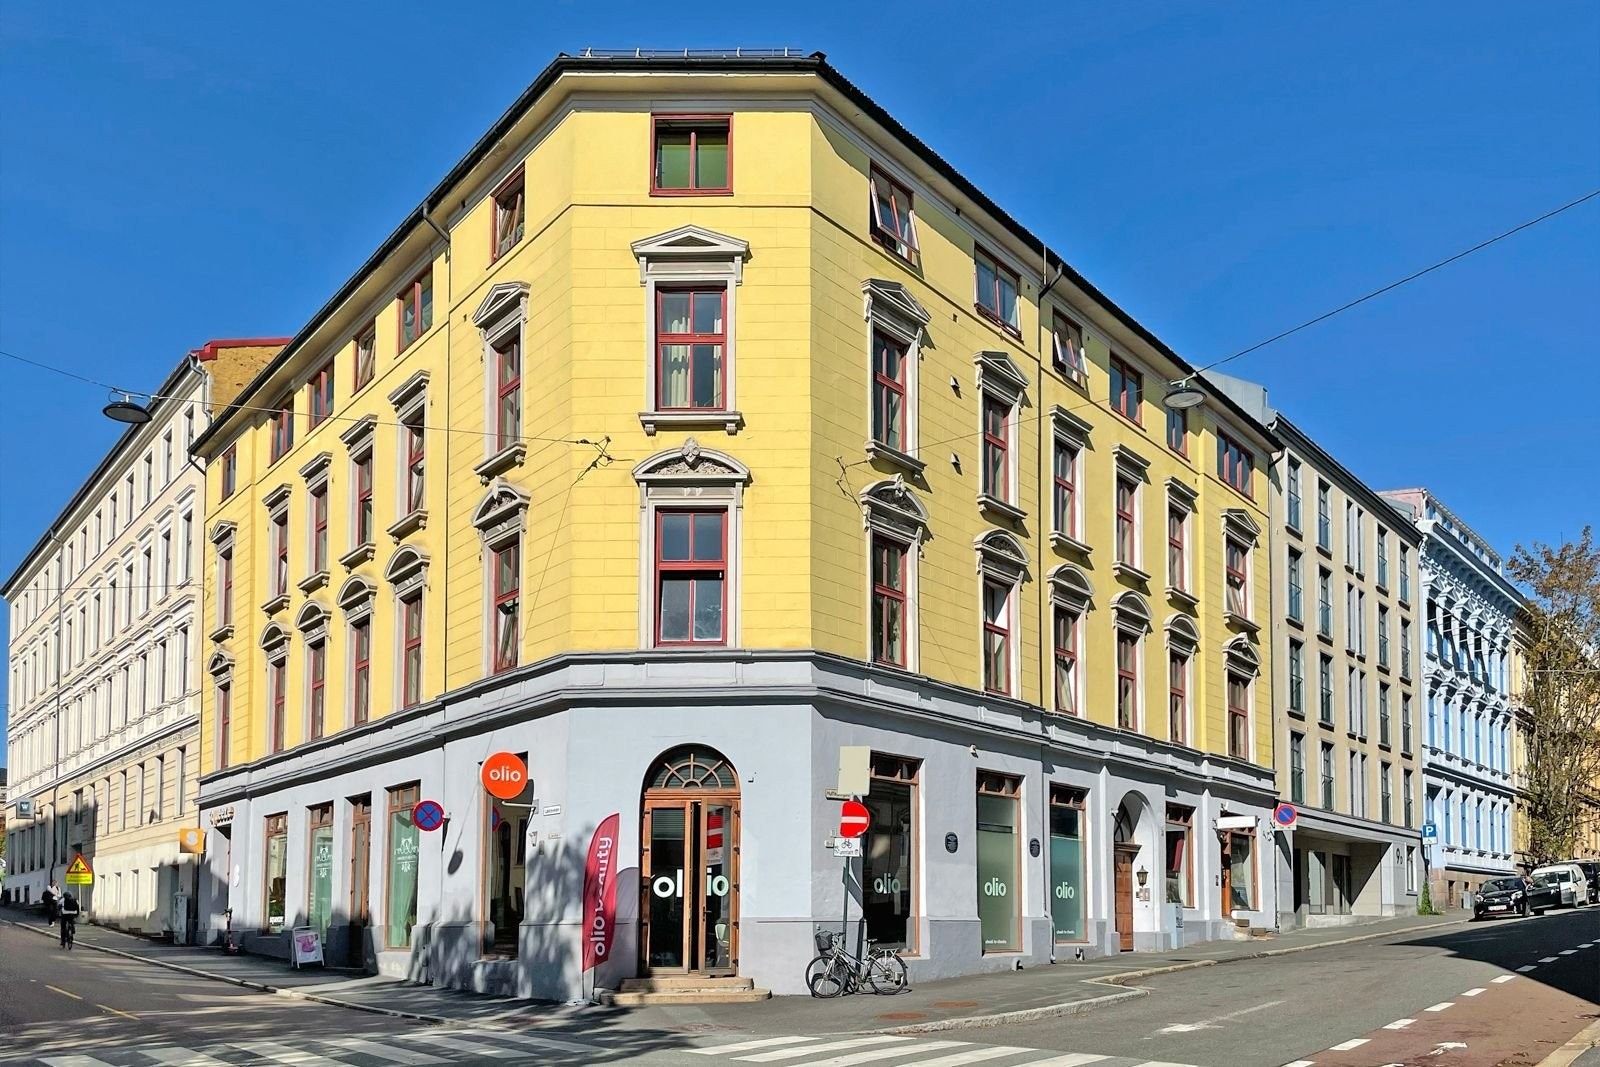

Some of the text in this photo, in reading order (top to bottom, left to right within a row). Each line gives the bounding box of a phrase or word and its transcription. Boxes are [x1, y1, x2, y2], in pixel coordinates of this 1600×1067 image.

[490, 766, 521, 782] olio
[1426, 826, 1434, 836] P
[874, 873, 900, 894] olio
[984, 877, 1007, 897] olio
[1056, 881, 1074, 899] olio
